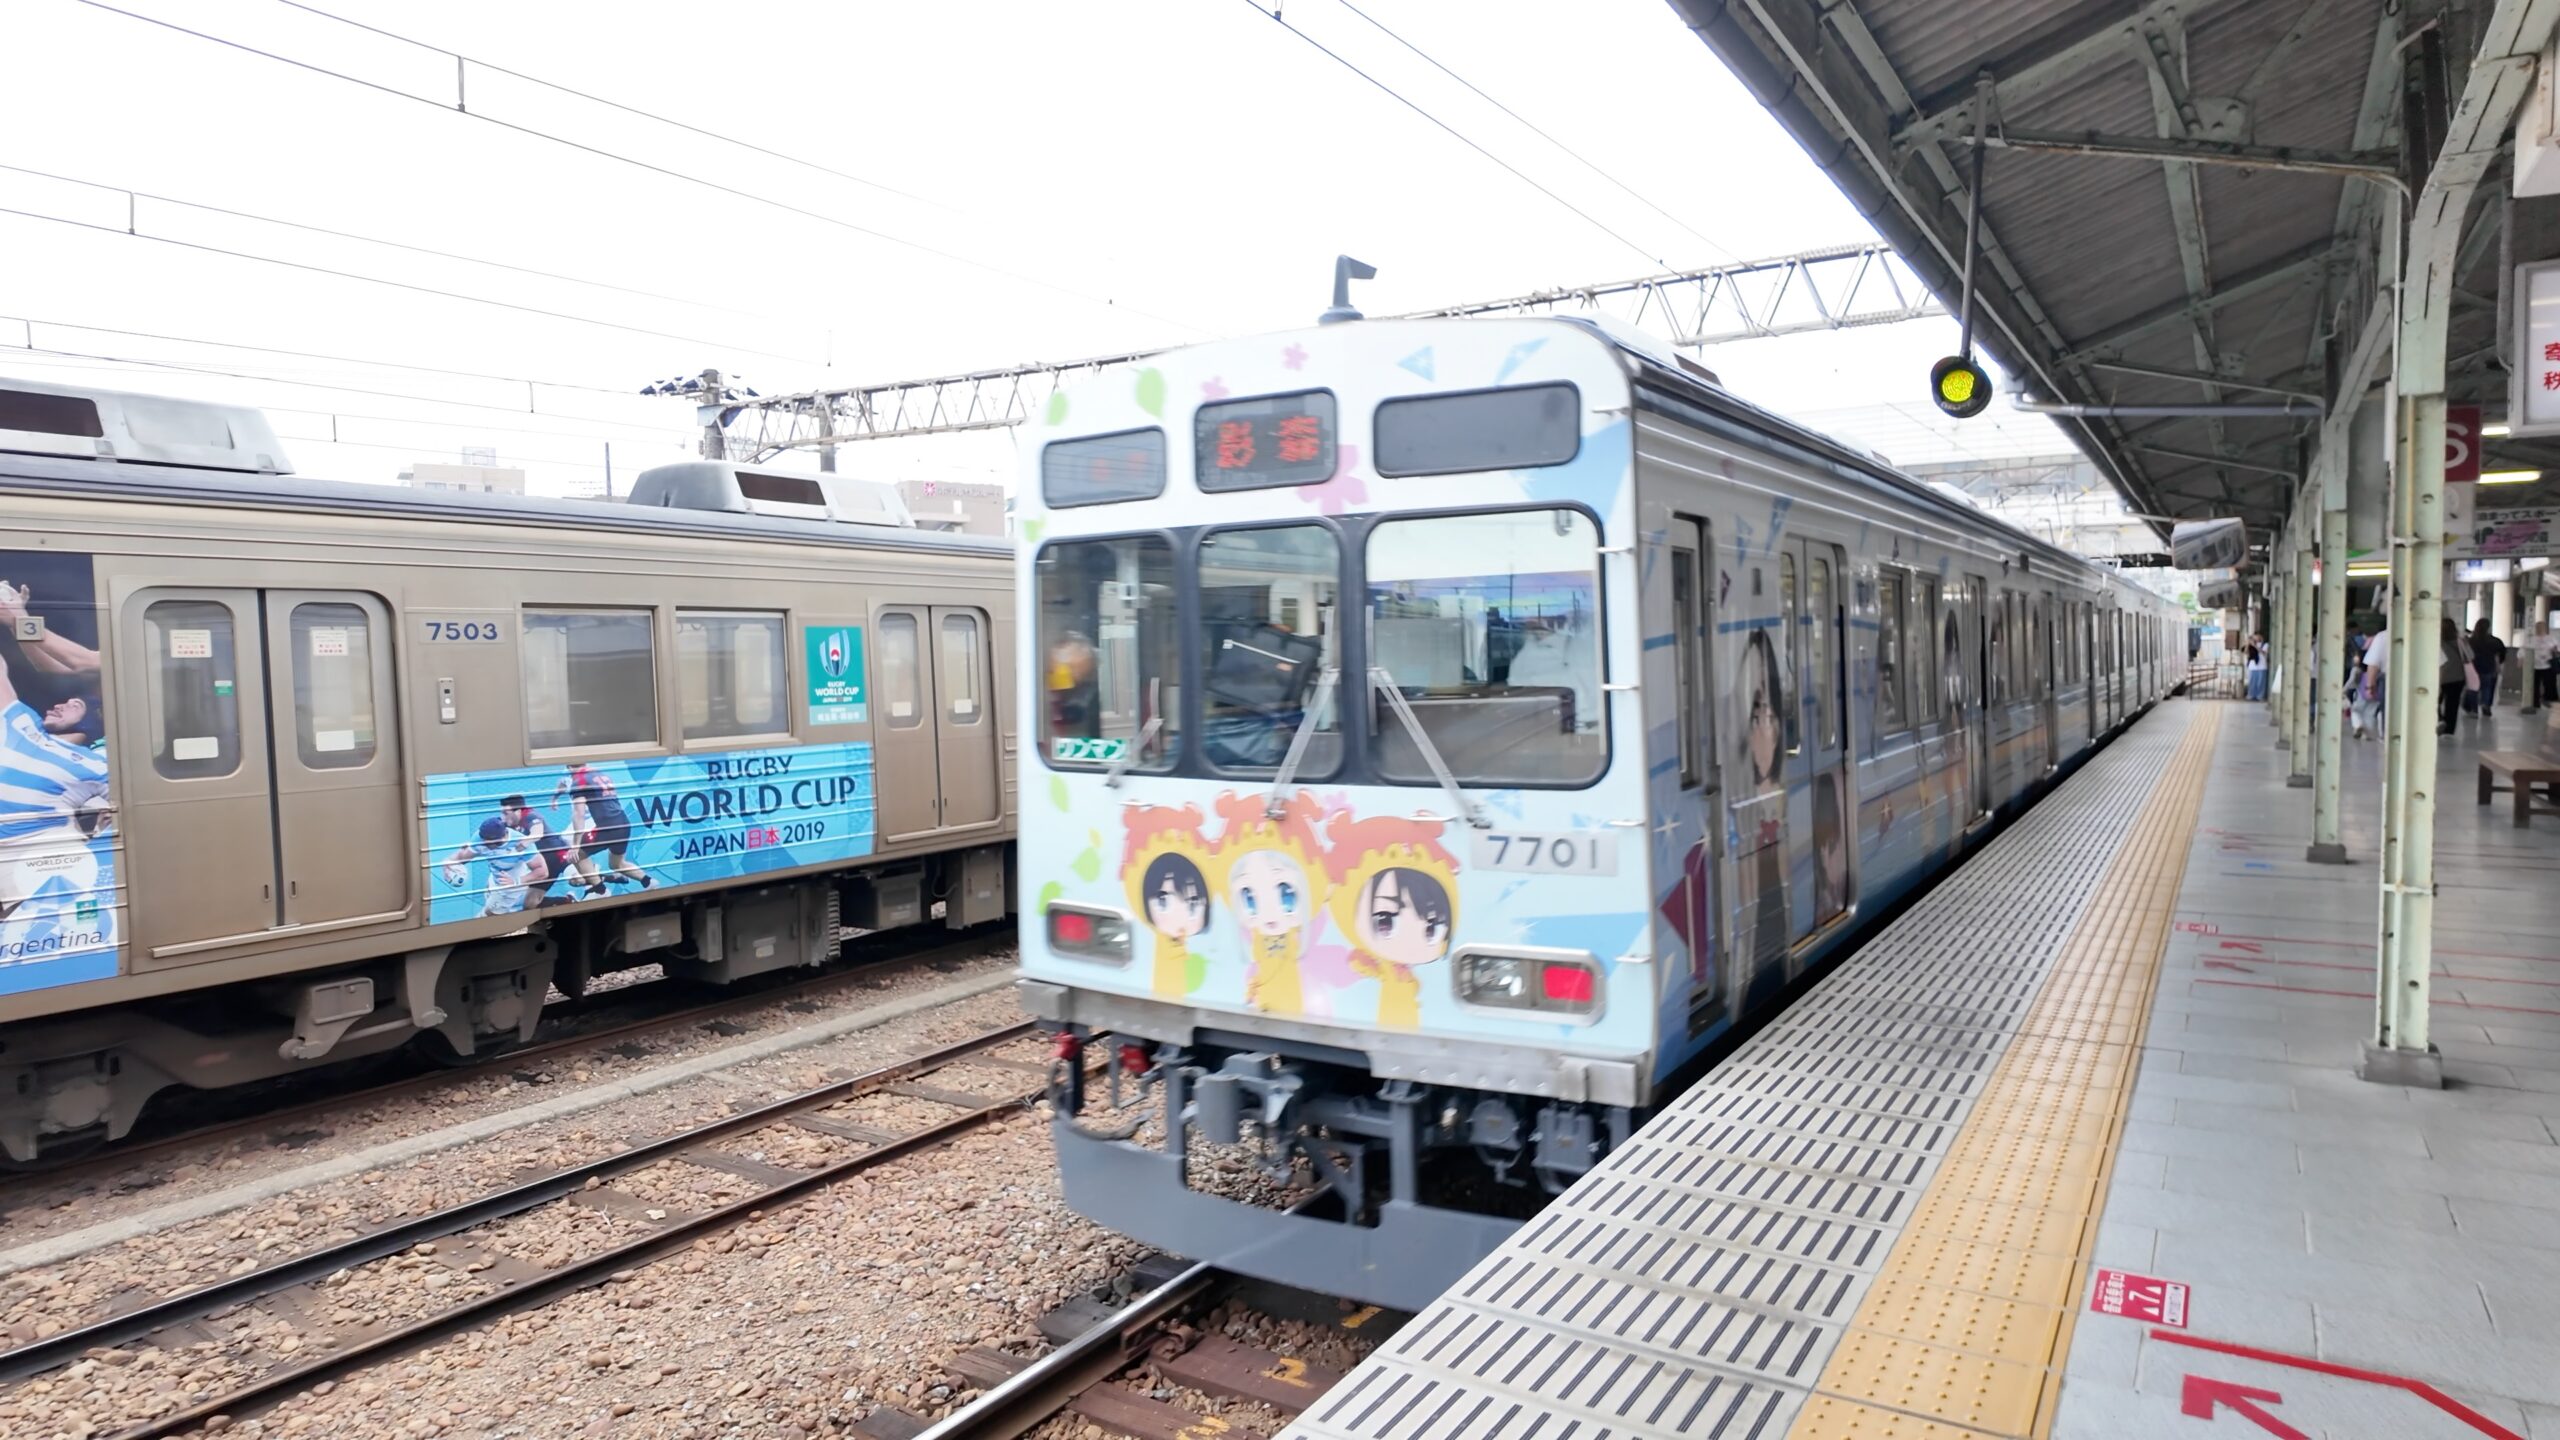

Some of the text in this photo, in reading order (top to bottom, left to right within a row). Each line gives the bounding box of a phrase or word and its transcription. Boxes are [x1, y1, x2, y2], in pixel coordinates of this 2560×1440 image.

[23, 622, 37, 636] 3
[426, 622, 498, 641] 7503
[815, 686, 860, 697] WORLD CUP
[707, 755, 793, 782] RUGBY
[634, 783, 783, 830] WORLD
[790, 775, 857, 810] CUP
[674, 820, 825, 860] JAPAN 日本 2019
[1487, 834, 1597, 870] 7701
[25, 858, 61, 868] WORLD
[62, 856, 82, 865] CUP
[2128, 1290, 2161, 1305] 7
